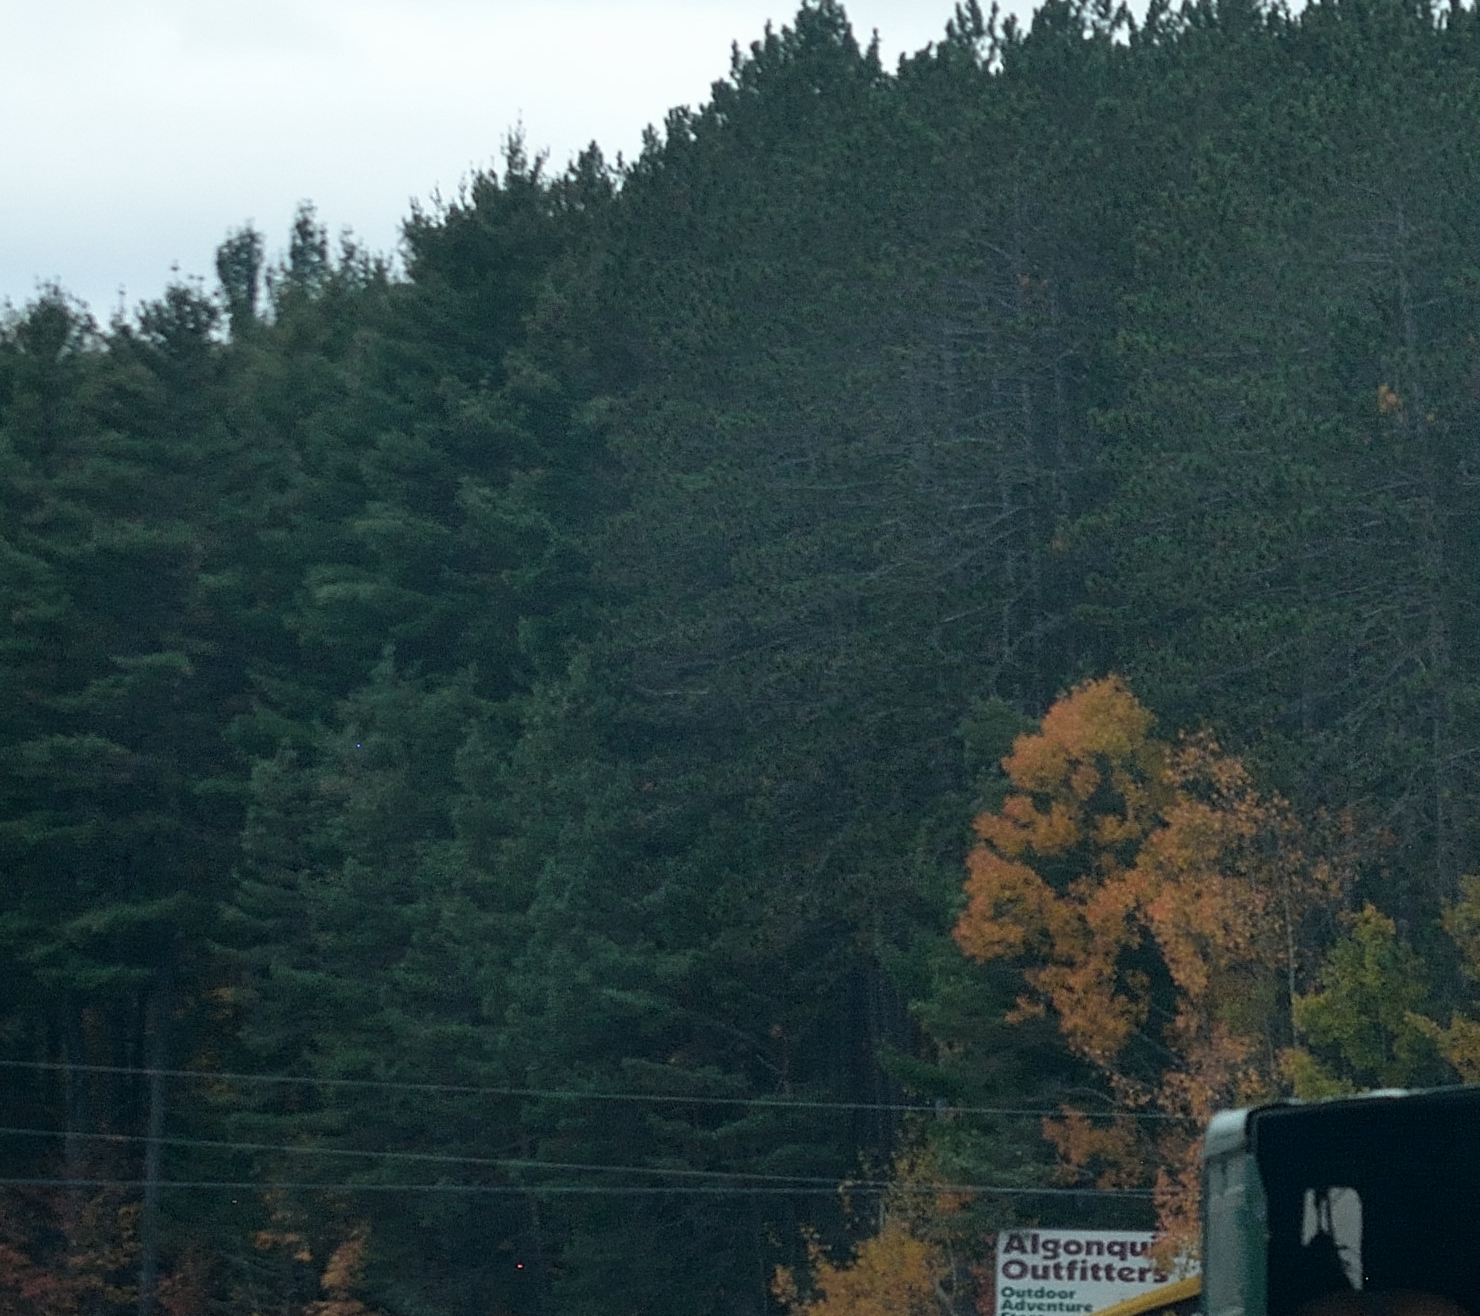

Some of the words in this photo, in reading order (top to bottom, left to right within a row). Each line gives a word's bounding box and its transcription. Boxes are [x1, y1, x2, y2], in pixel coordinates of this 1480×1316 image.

[1002, 1233, 1162, 1261] Algonqu
[1001, 1258, 1169, 1283] Outfitters
[1000, 1286, 1076, 1299] Outdoor
[1000, 1300, 1094, 1313] Adventure
